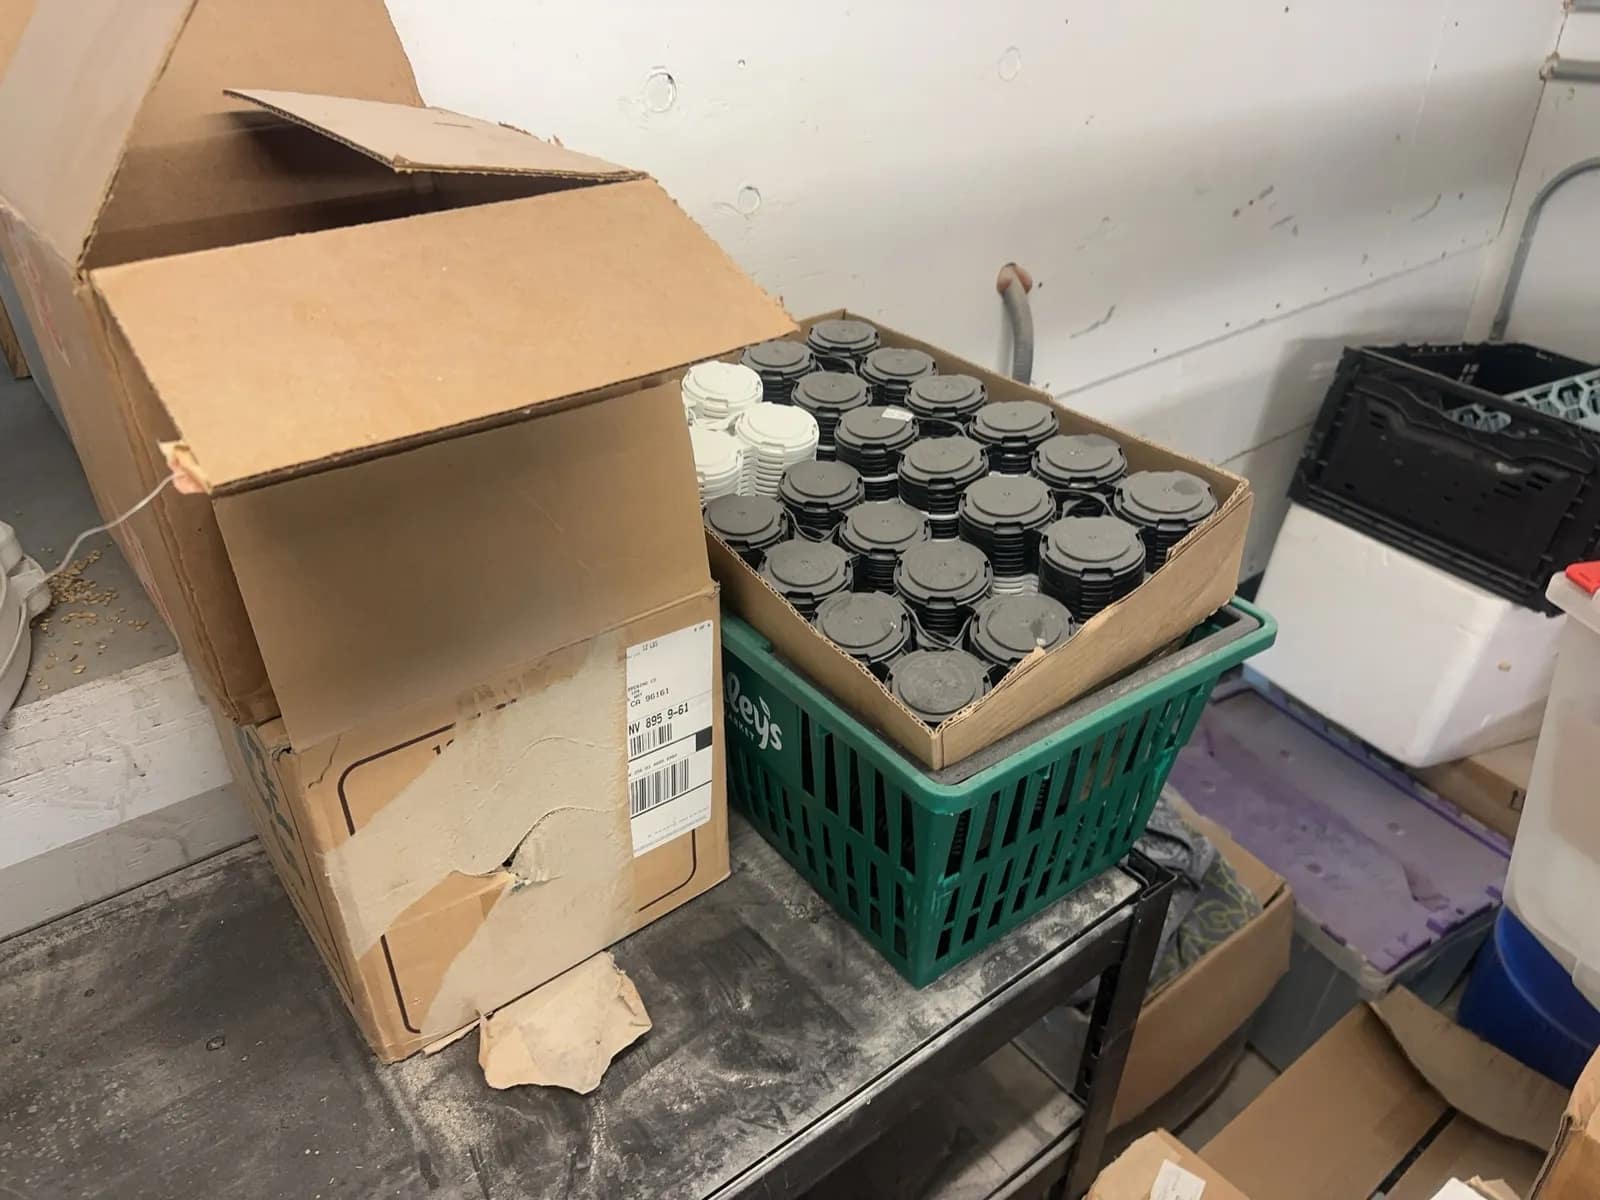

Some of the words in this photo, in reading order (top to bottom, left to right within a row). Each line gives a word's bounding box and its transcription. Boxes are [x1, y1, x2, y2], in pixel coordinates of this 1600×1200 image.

[630, 699, 641, 708] CA
[628, 721, 641, 736] NV
[646, 712, 663, 729] 895
[667, 702, 689, 720] 9-61
